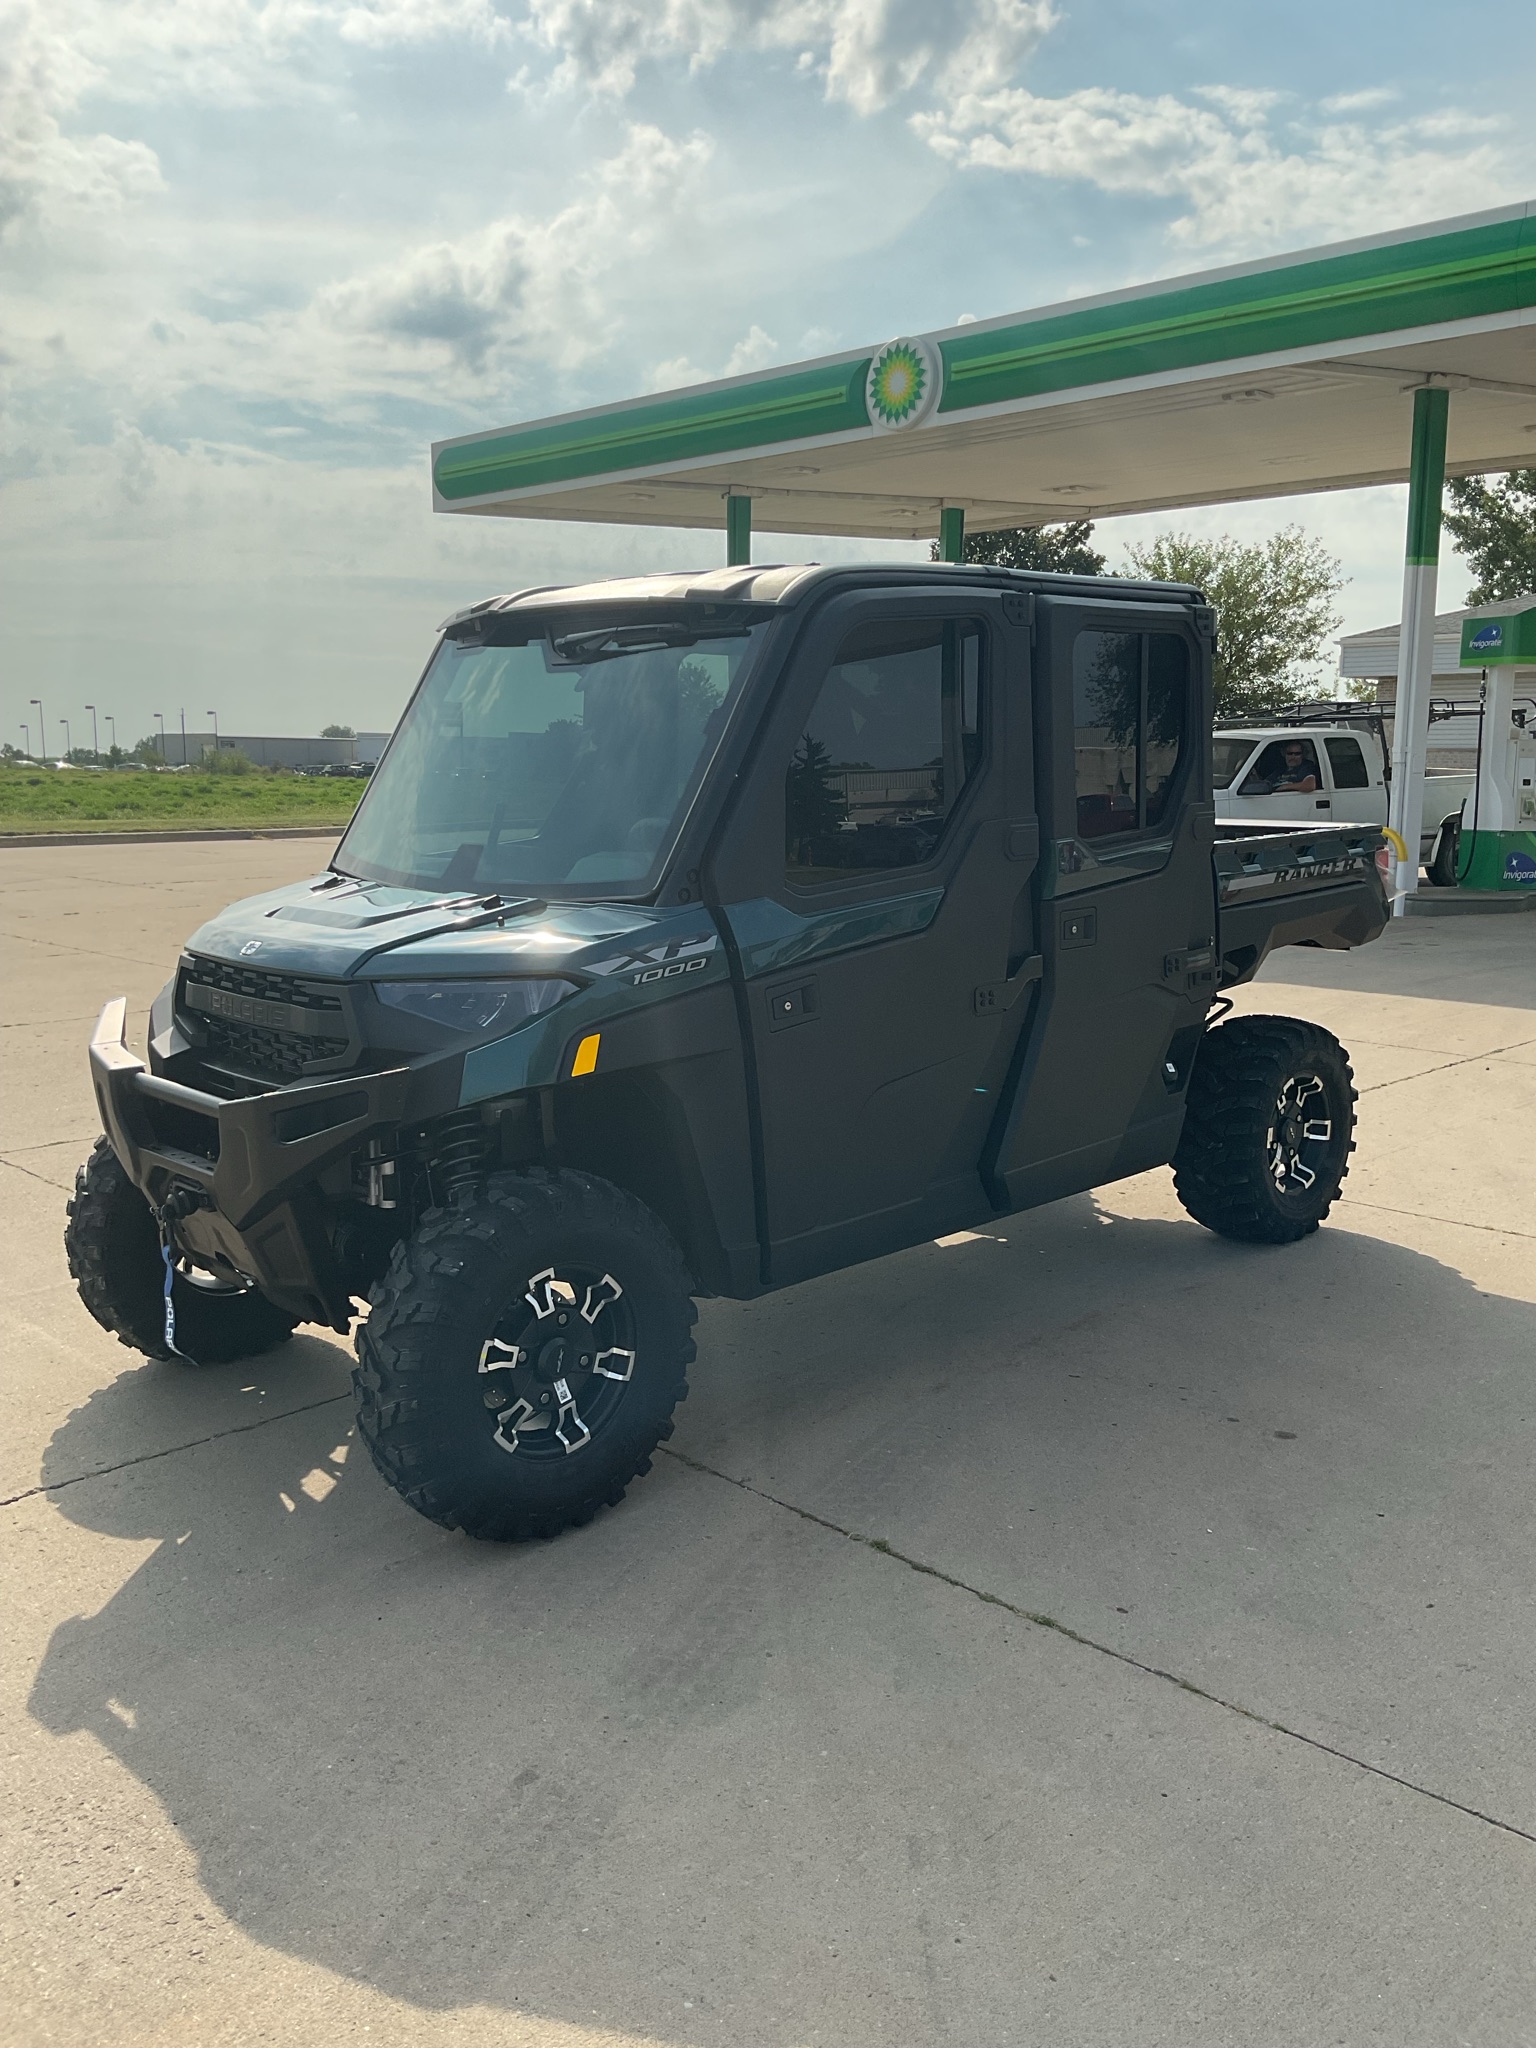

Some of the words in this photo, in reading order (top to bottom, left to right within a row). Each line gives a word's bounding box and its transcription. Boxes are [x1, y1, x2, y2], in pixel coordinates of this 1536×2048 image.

[1469, 639, 1502, 649] Invigorate
[1274, 857, 1358, 883] RANGER
[1503, 870, 1536, 882] Invigorat
[607, 930, 714, 974] XP
[633, 957, 707, 985] 1000
